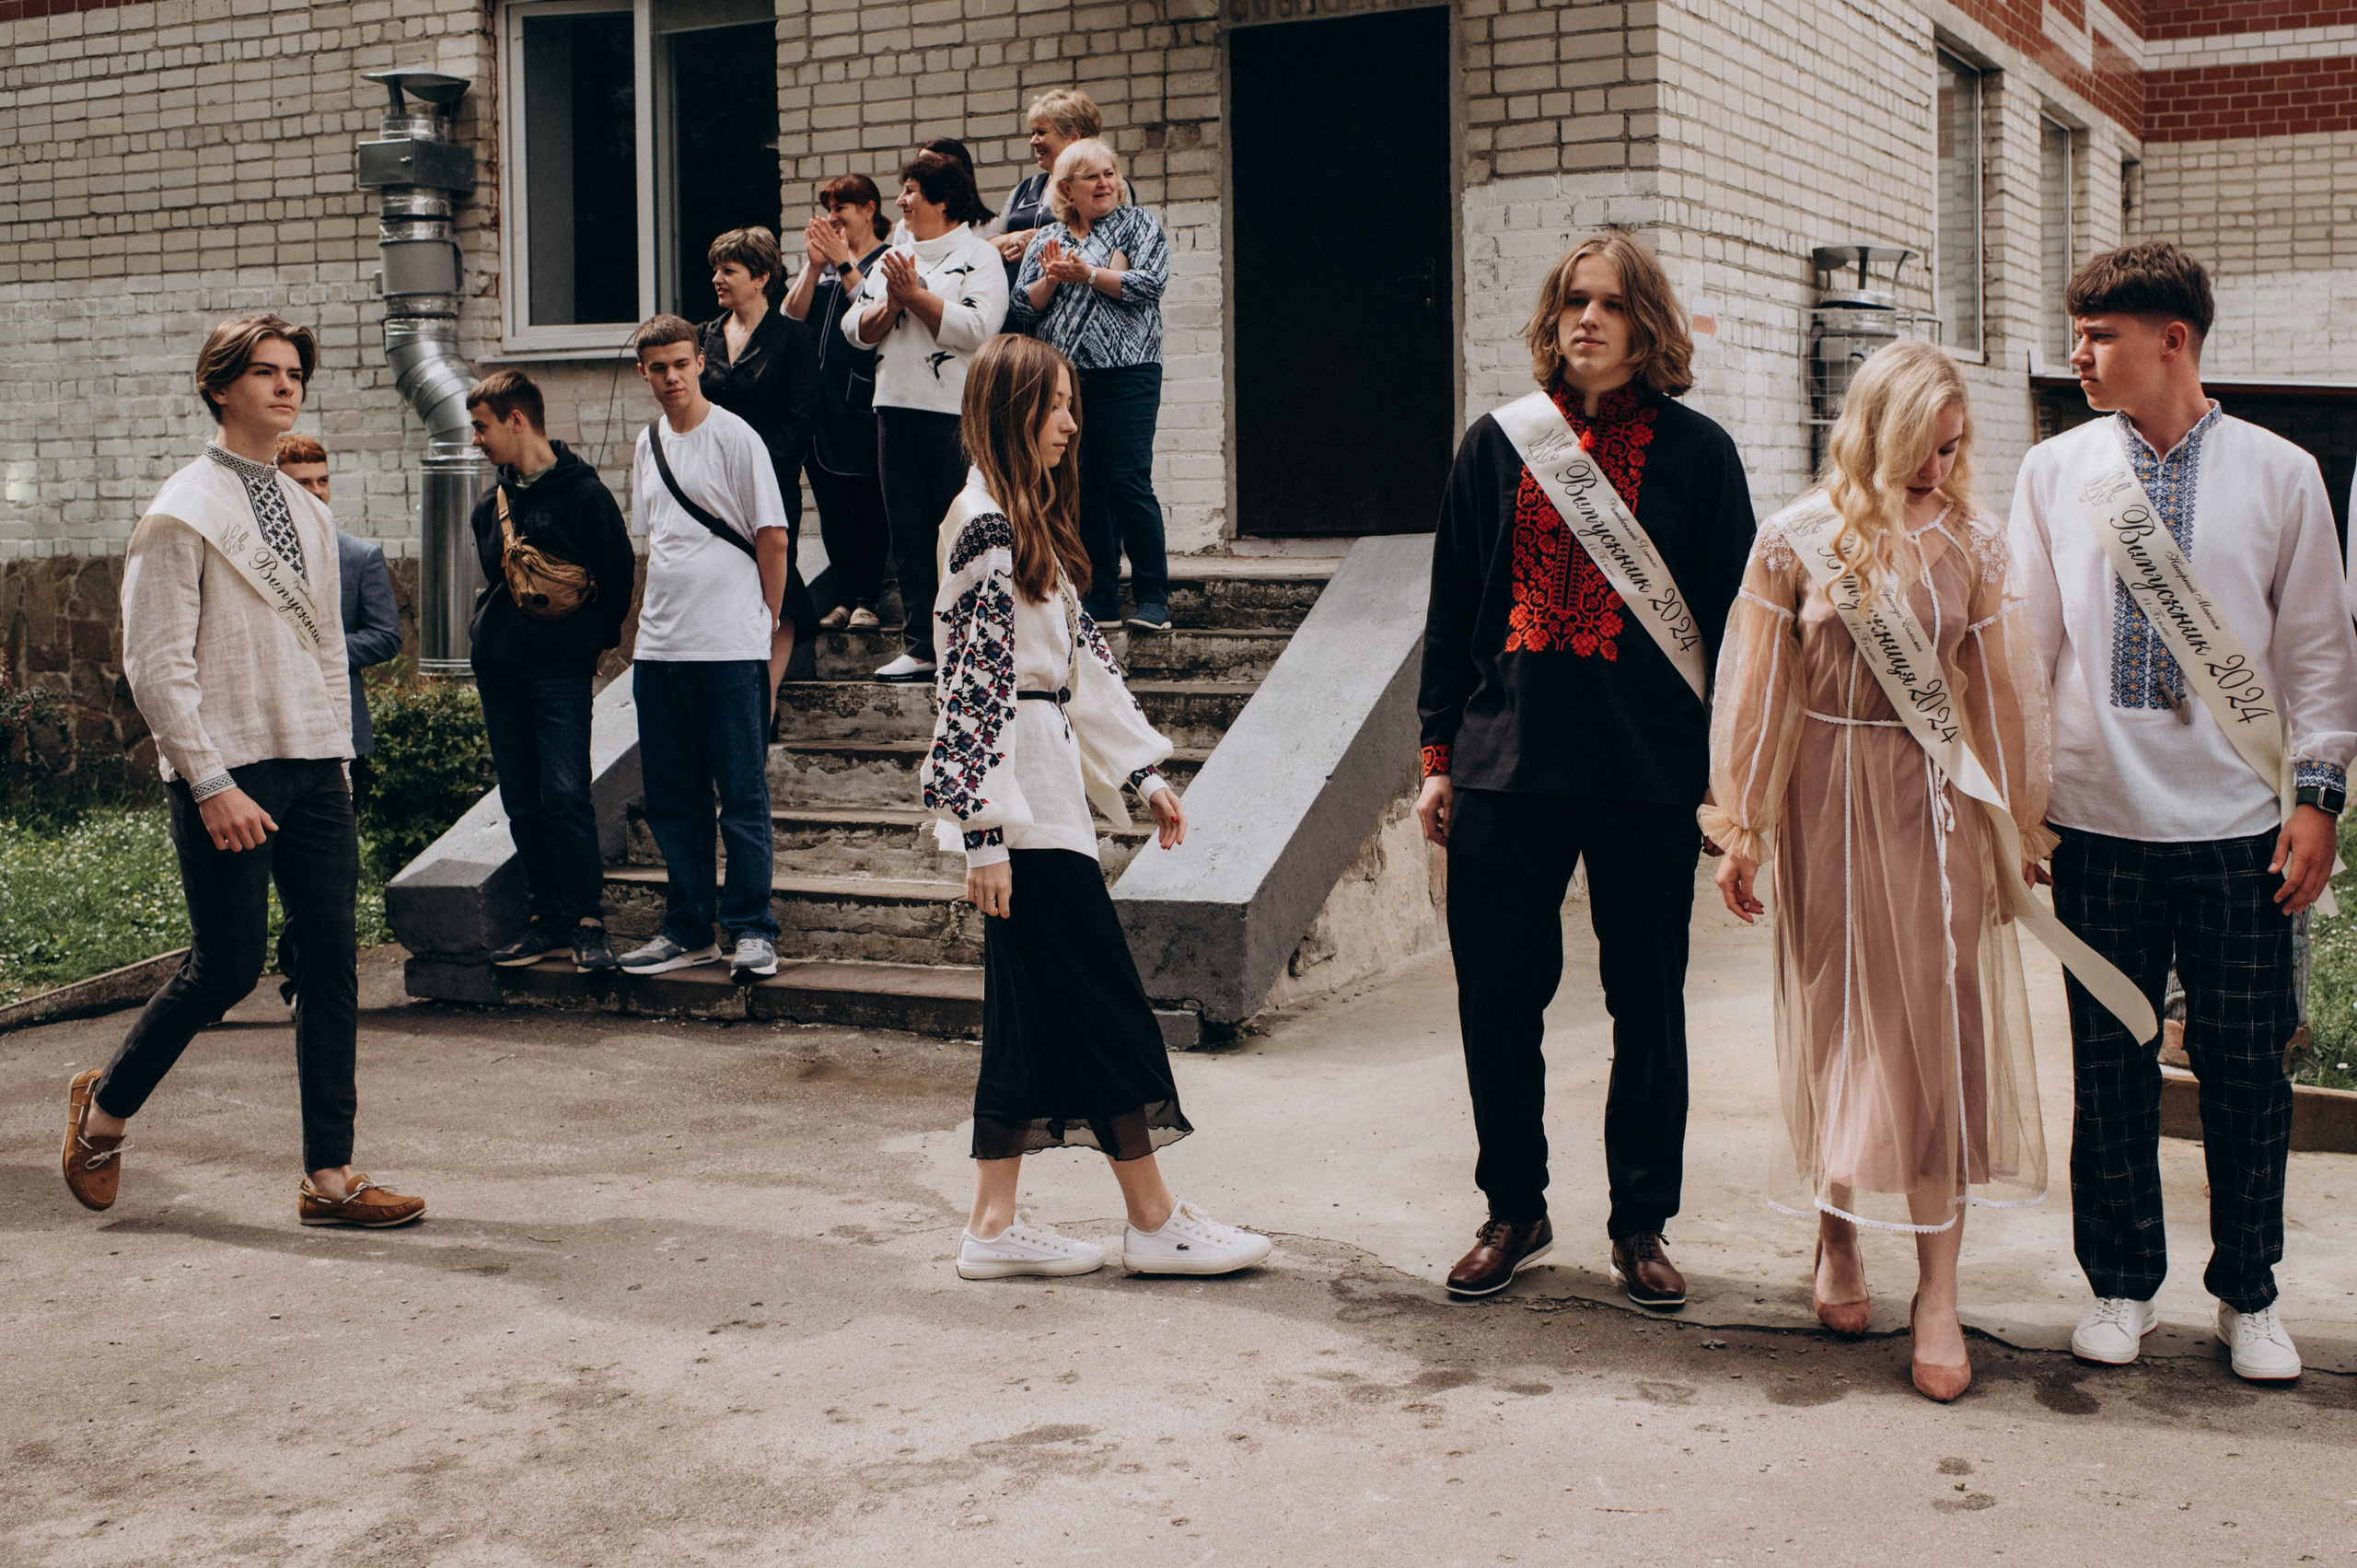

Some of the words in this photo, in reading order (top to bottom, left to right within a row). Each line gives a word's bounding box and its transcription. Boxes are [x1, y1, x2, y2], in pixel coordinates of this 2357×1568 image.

[1555, 460, 1653, 593] Випускник
[1647, 587, 1700, 653] 2024
[2165, 552, 2197, 596] Нагорний
[2194, 594, 2221, 631] Максим
[1851, 622, 1873, 645] 11-Б
[1864, 646, 1877, 663] клас
[2110, 505, 2212, 656] Випускник
[2204, 655, 2275, 724] 2024
[1909, 679, 1958, 743] 2024
